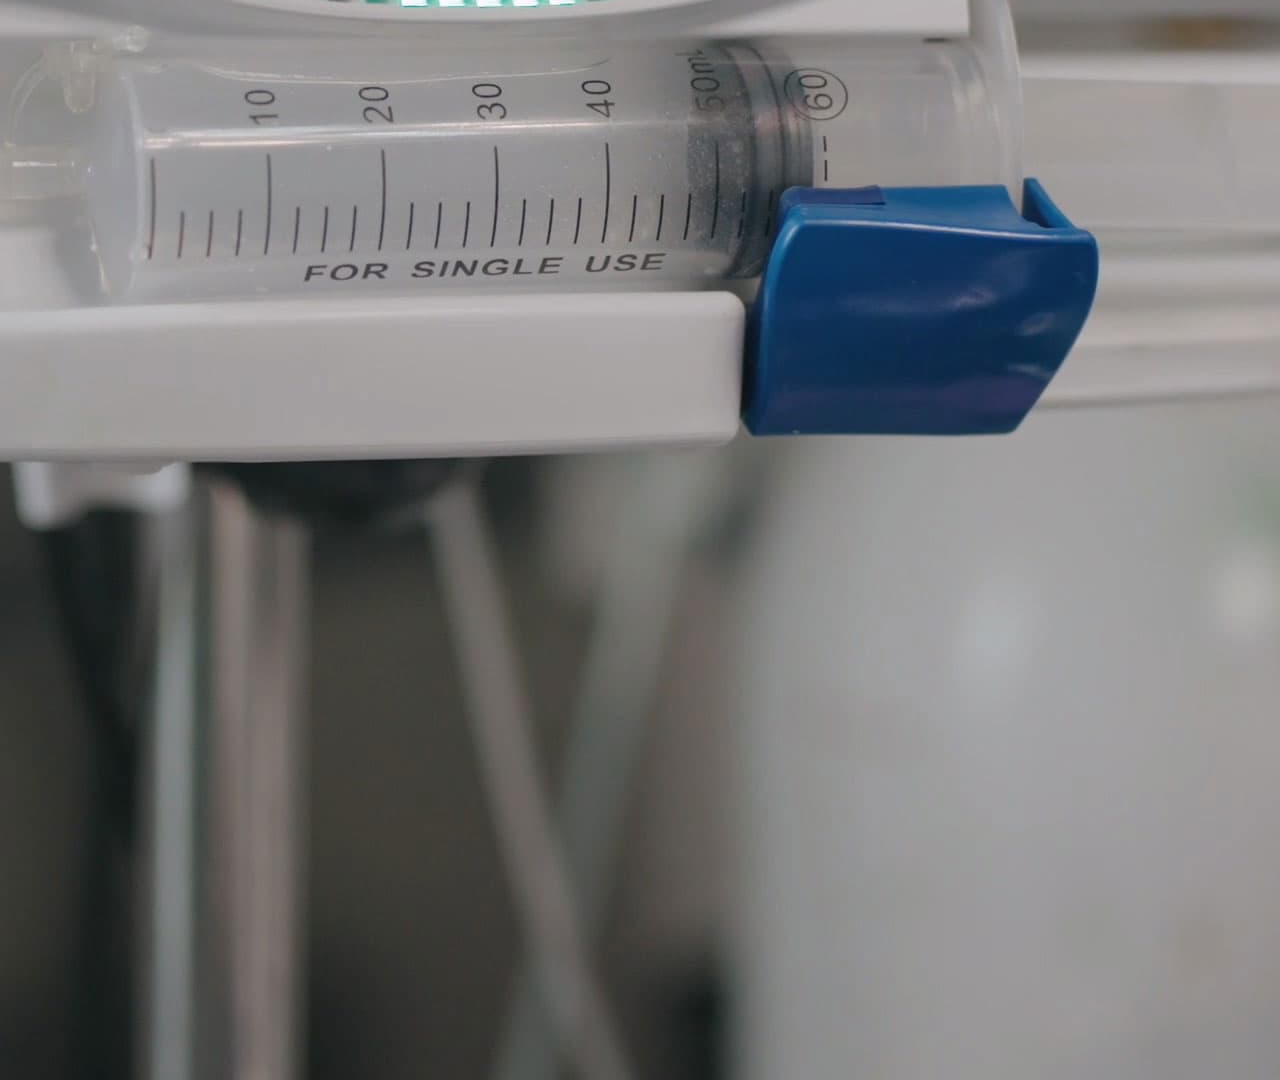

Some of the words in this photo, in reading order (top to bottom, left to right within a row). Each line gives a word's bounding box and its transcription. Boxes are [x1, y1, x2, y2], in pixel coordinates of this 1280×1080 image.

[244, 88, 278, 126] 10
[357, 85, 395, 124] 20
[471, 81, 509, 119] 30
[582, 78, 614, 119] 40
[799, 74, 833, 110] 60
[303, 263, 388, 283] FOR
[410, 256, 562, 280] SINGLE
[584, 251, 667, 273] USE
